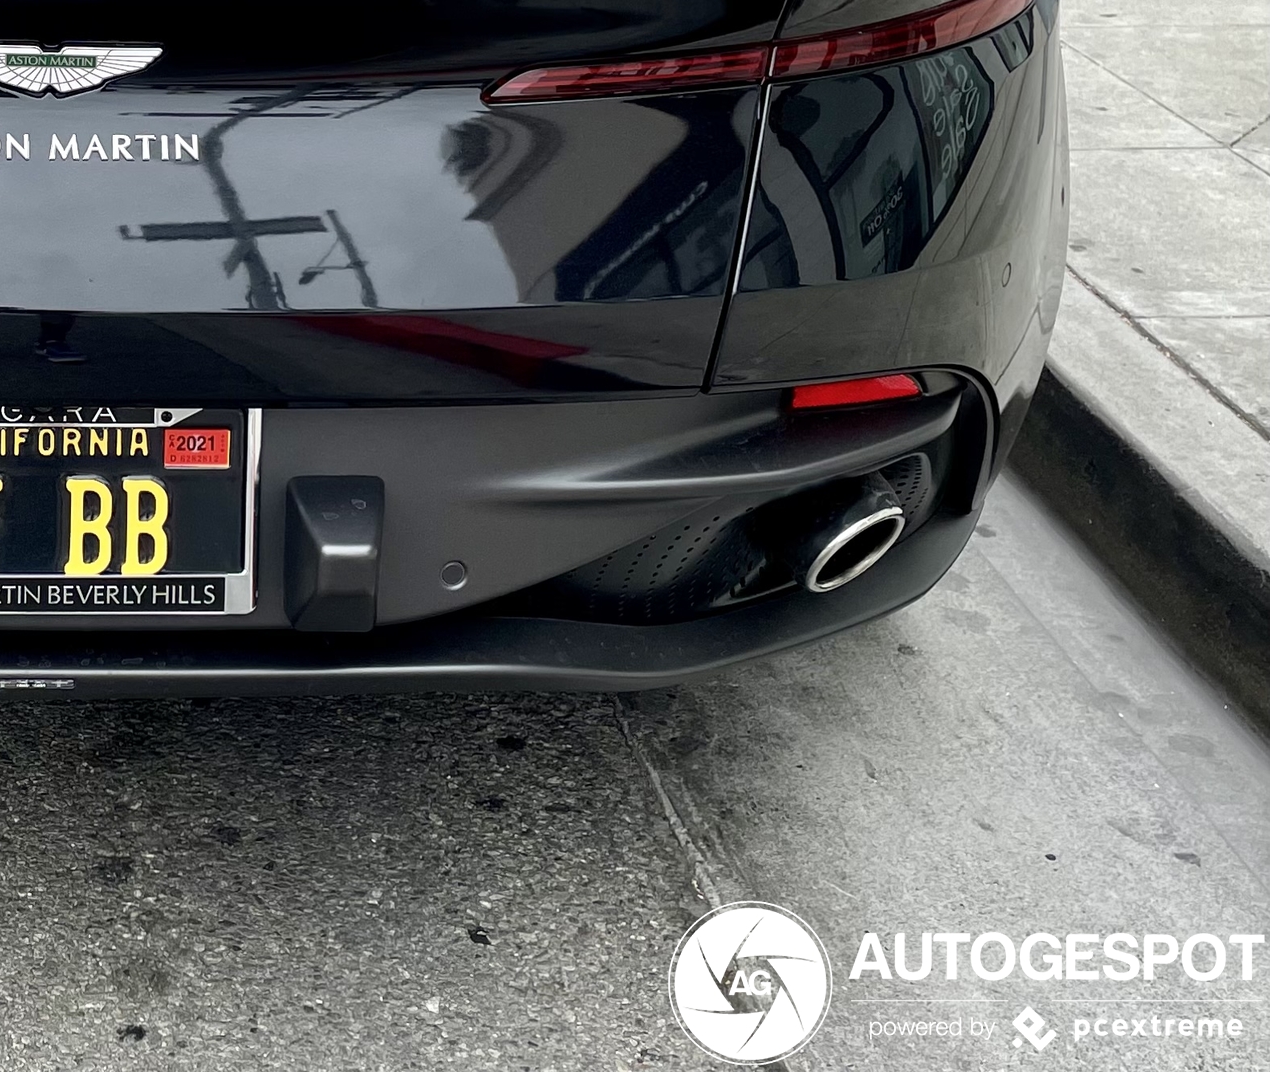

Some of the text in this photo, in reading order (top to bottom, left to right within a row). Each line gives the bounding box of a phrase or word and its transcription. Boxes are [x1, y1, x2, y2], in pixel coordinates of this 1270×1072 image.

[8, 56, 93, 66] ASTON MARTIN
[48, 133, 200, 161] MARTIN
[176, 435, 215, 451] 2021
[64, 478, 169, 576] BB
[47, 584, 147, 605] BEVERLY
[151, 584, 216, 605] HILLS
